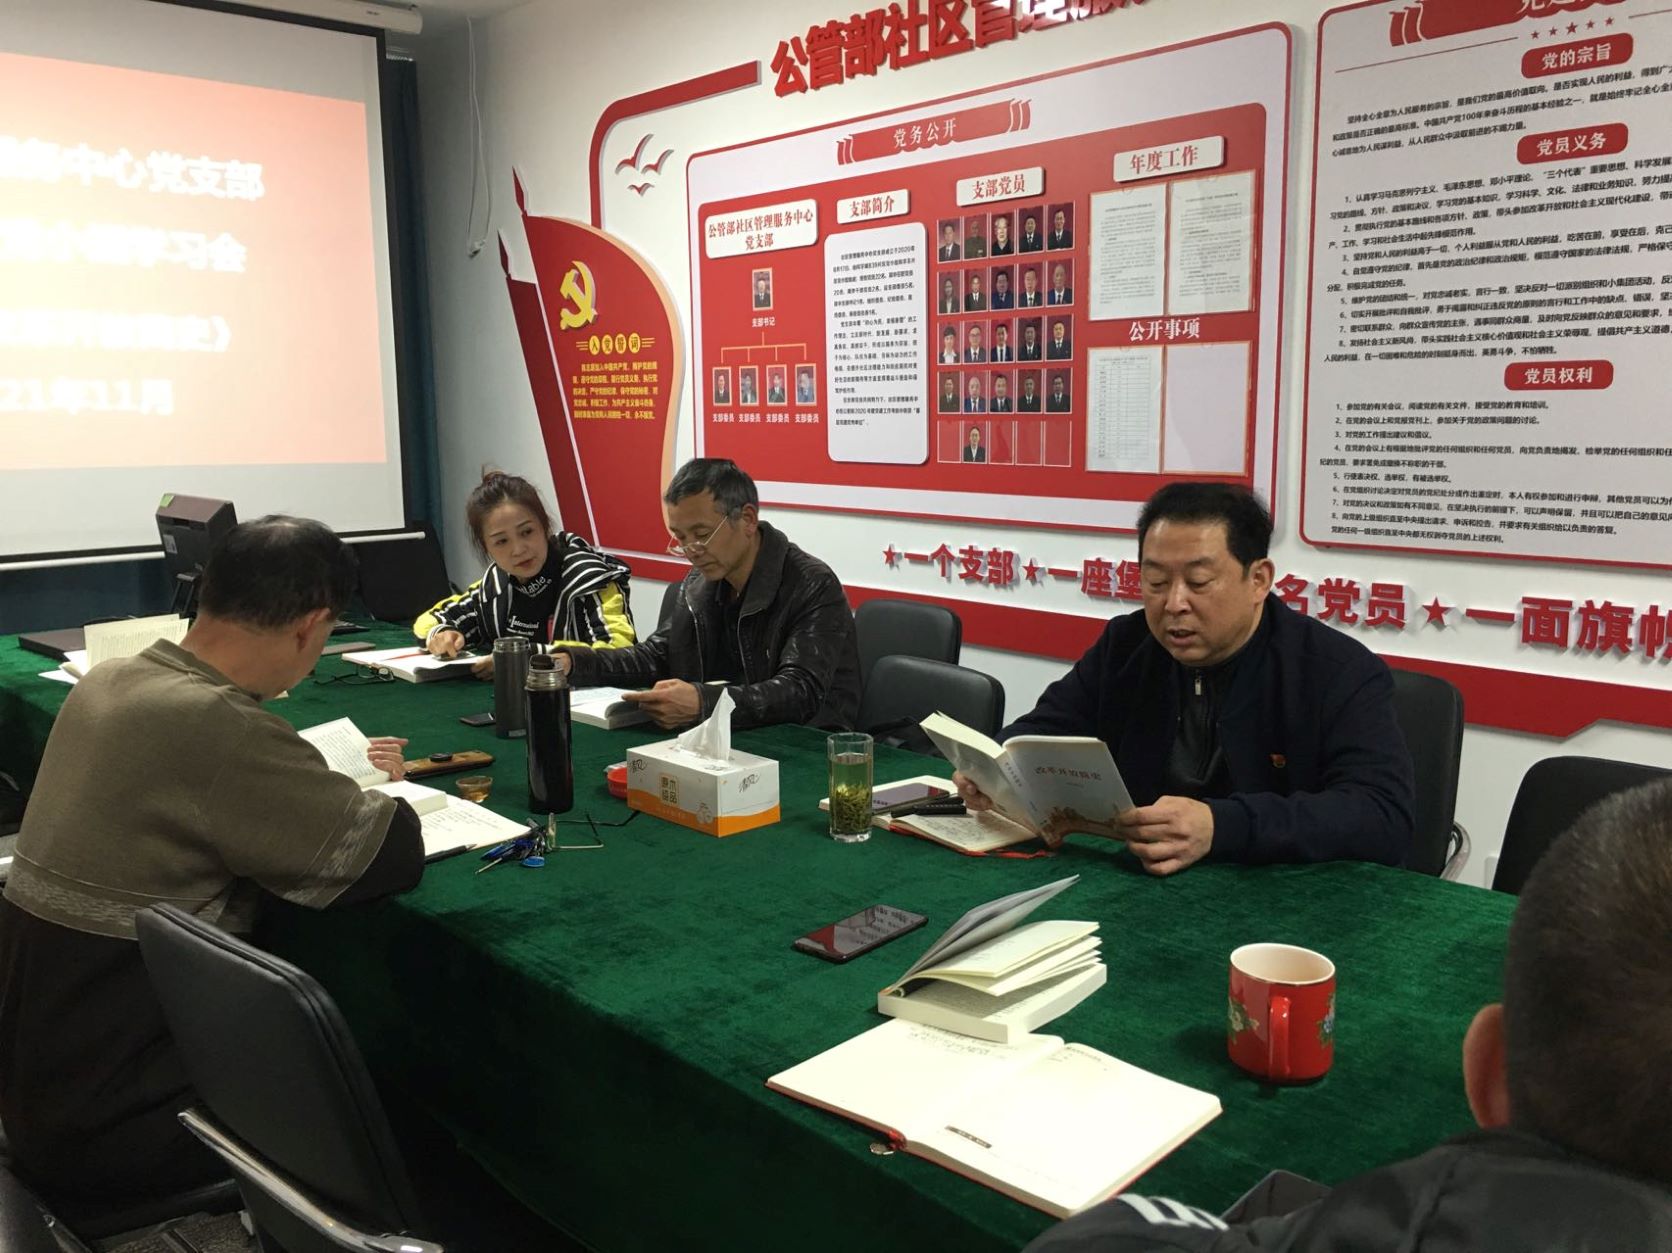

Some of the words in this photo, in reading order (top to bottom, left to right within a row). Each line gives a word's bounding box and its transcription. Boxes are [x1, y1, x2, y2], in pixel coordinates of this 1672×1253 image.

[1542, 43, 1611, 70] 党的宗旨
[893, 117, 957, 149] 党务公开
[1537, 133, 1606, 157] 党员义务
[1129, 146, 1198, 174] 年度工作
[972, 173, 1026, 200] 支部党员
[849, 195, 895, 217] 支部简介
[708, 208, 814, 238] 公管部社区管理服务中心
[745, 233, 774, 250] 党支部
[752, 316, 776, 328] 支部书记
[1129, 318, 1200, 341] 公开事项
[1525, 366, 1593, 384] 党员权利
[904, 543, 1014, 585] 一个支部
